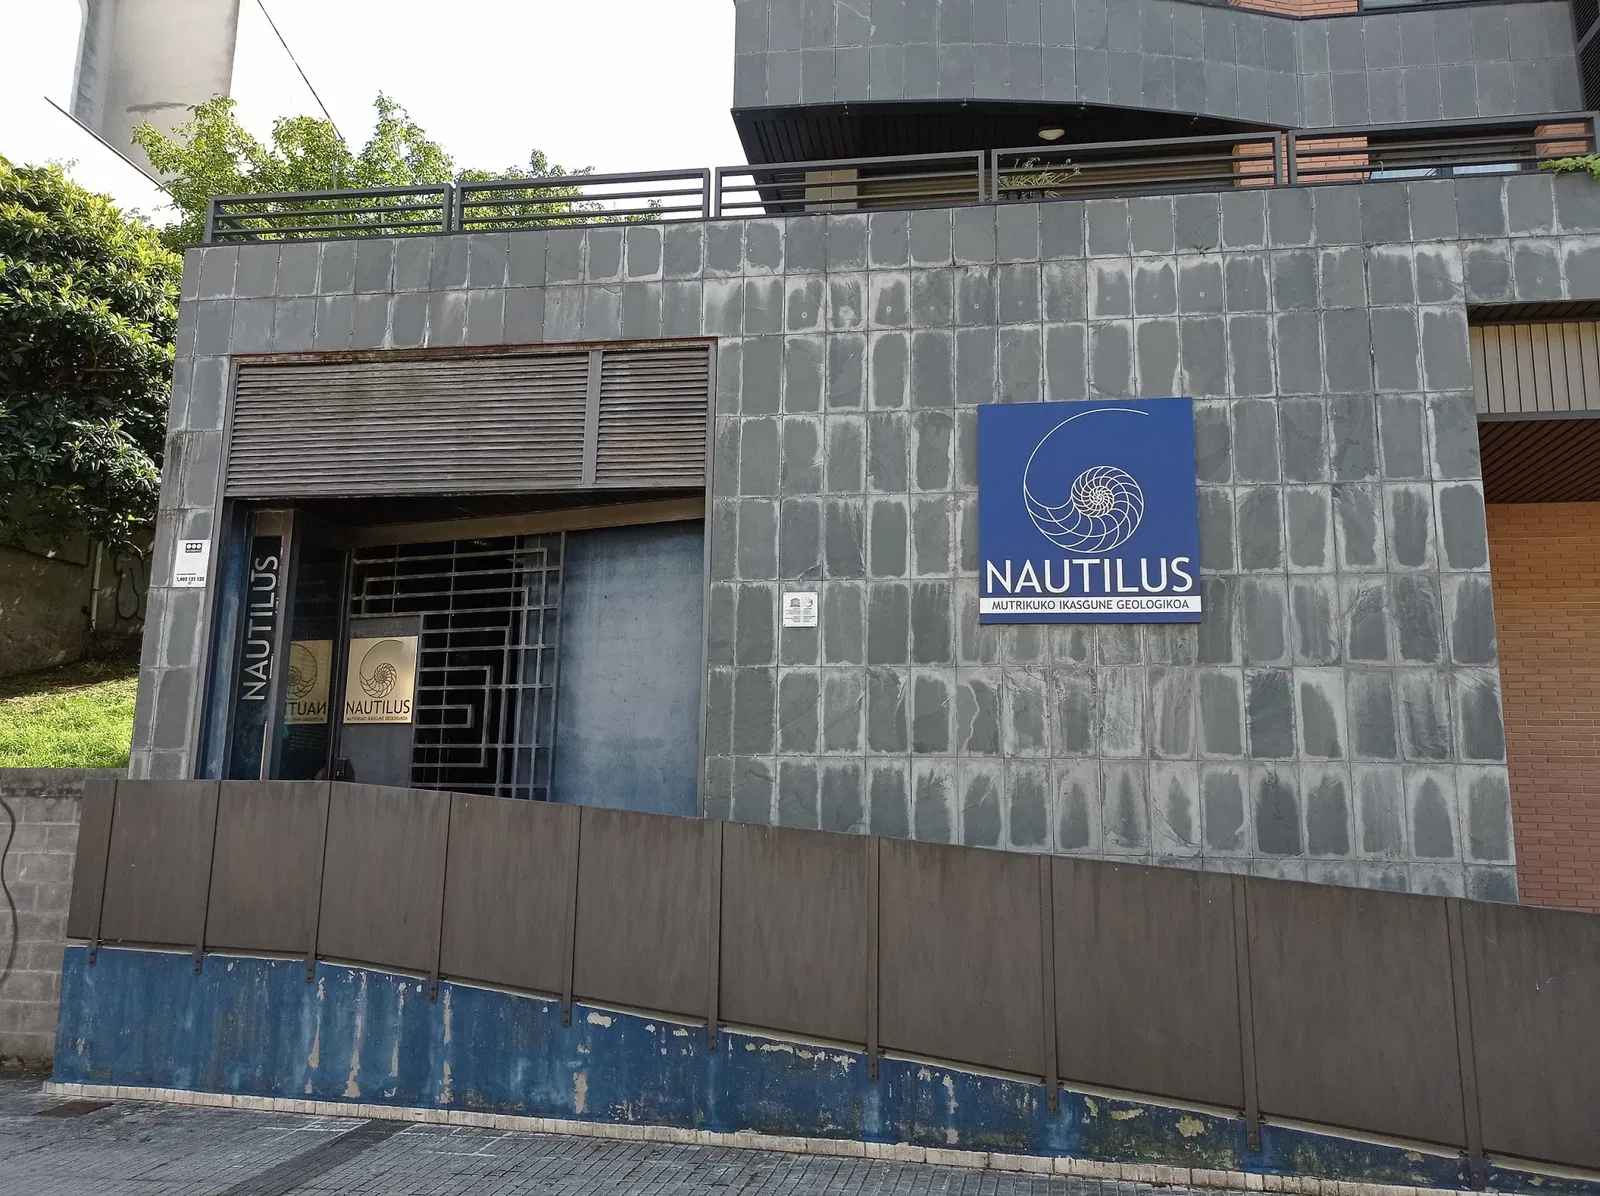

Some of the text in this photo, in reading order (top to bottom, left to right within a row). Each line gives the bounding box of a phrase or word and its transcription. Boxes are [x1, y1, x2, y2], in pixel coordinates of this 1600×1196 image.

[985, 556, 1194, 594] NAUTILUS
[991, 599, 1190, 611] MUTRIKUKO IKASGUNE GEOLOGIKOA
[241, 555, 279, 700] NAUTILUS
[345, 699, 410, 715] NAUTILUS
